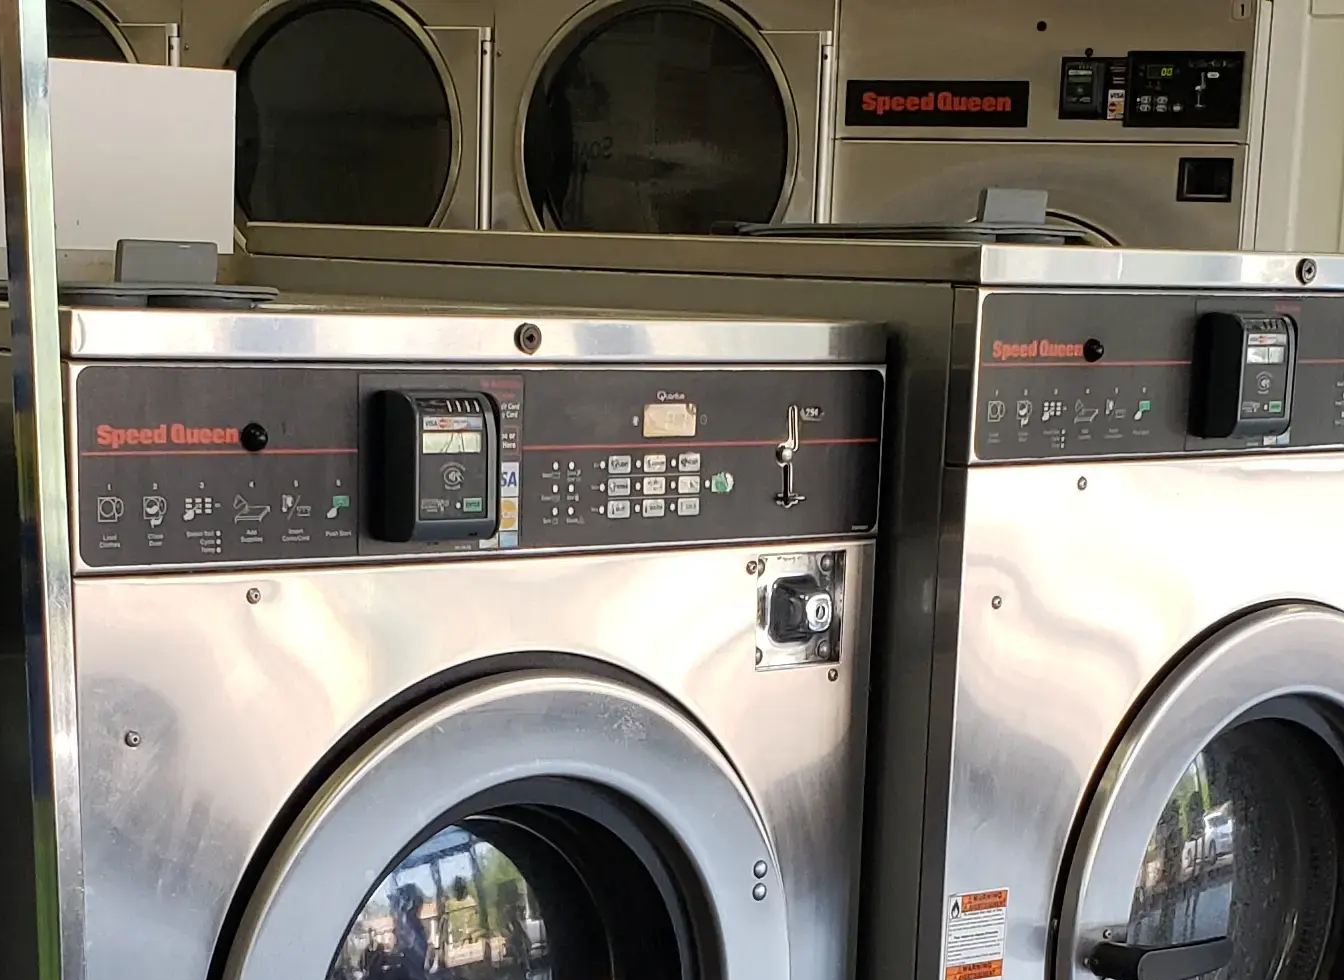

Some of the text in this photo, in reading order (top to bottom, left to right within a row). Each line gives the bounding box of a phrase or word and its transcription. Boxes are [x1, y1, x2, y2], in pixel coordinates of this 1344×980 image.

[862, 92, 1012, 115] Speed Queen
[992, 339, 1084, 361] Speed Queen
[97, 423, 241, 449] Speed Queen
